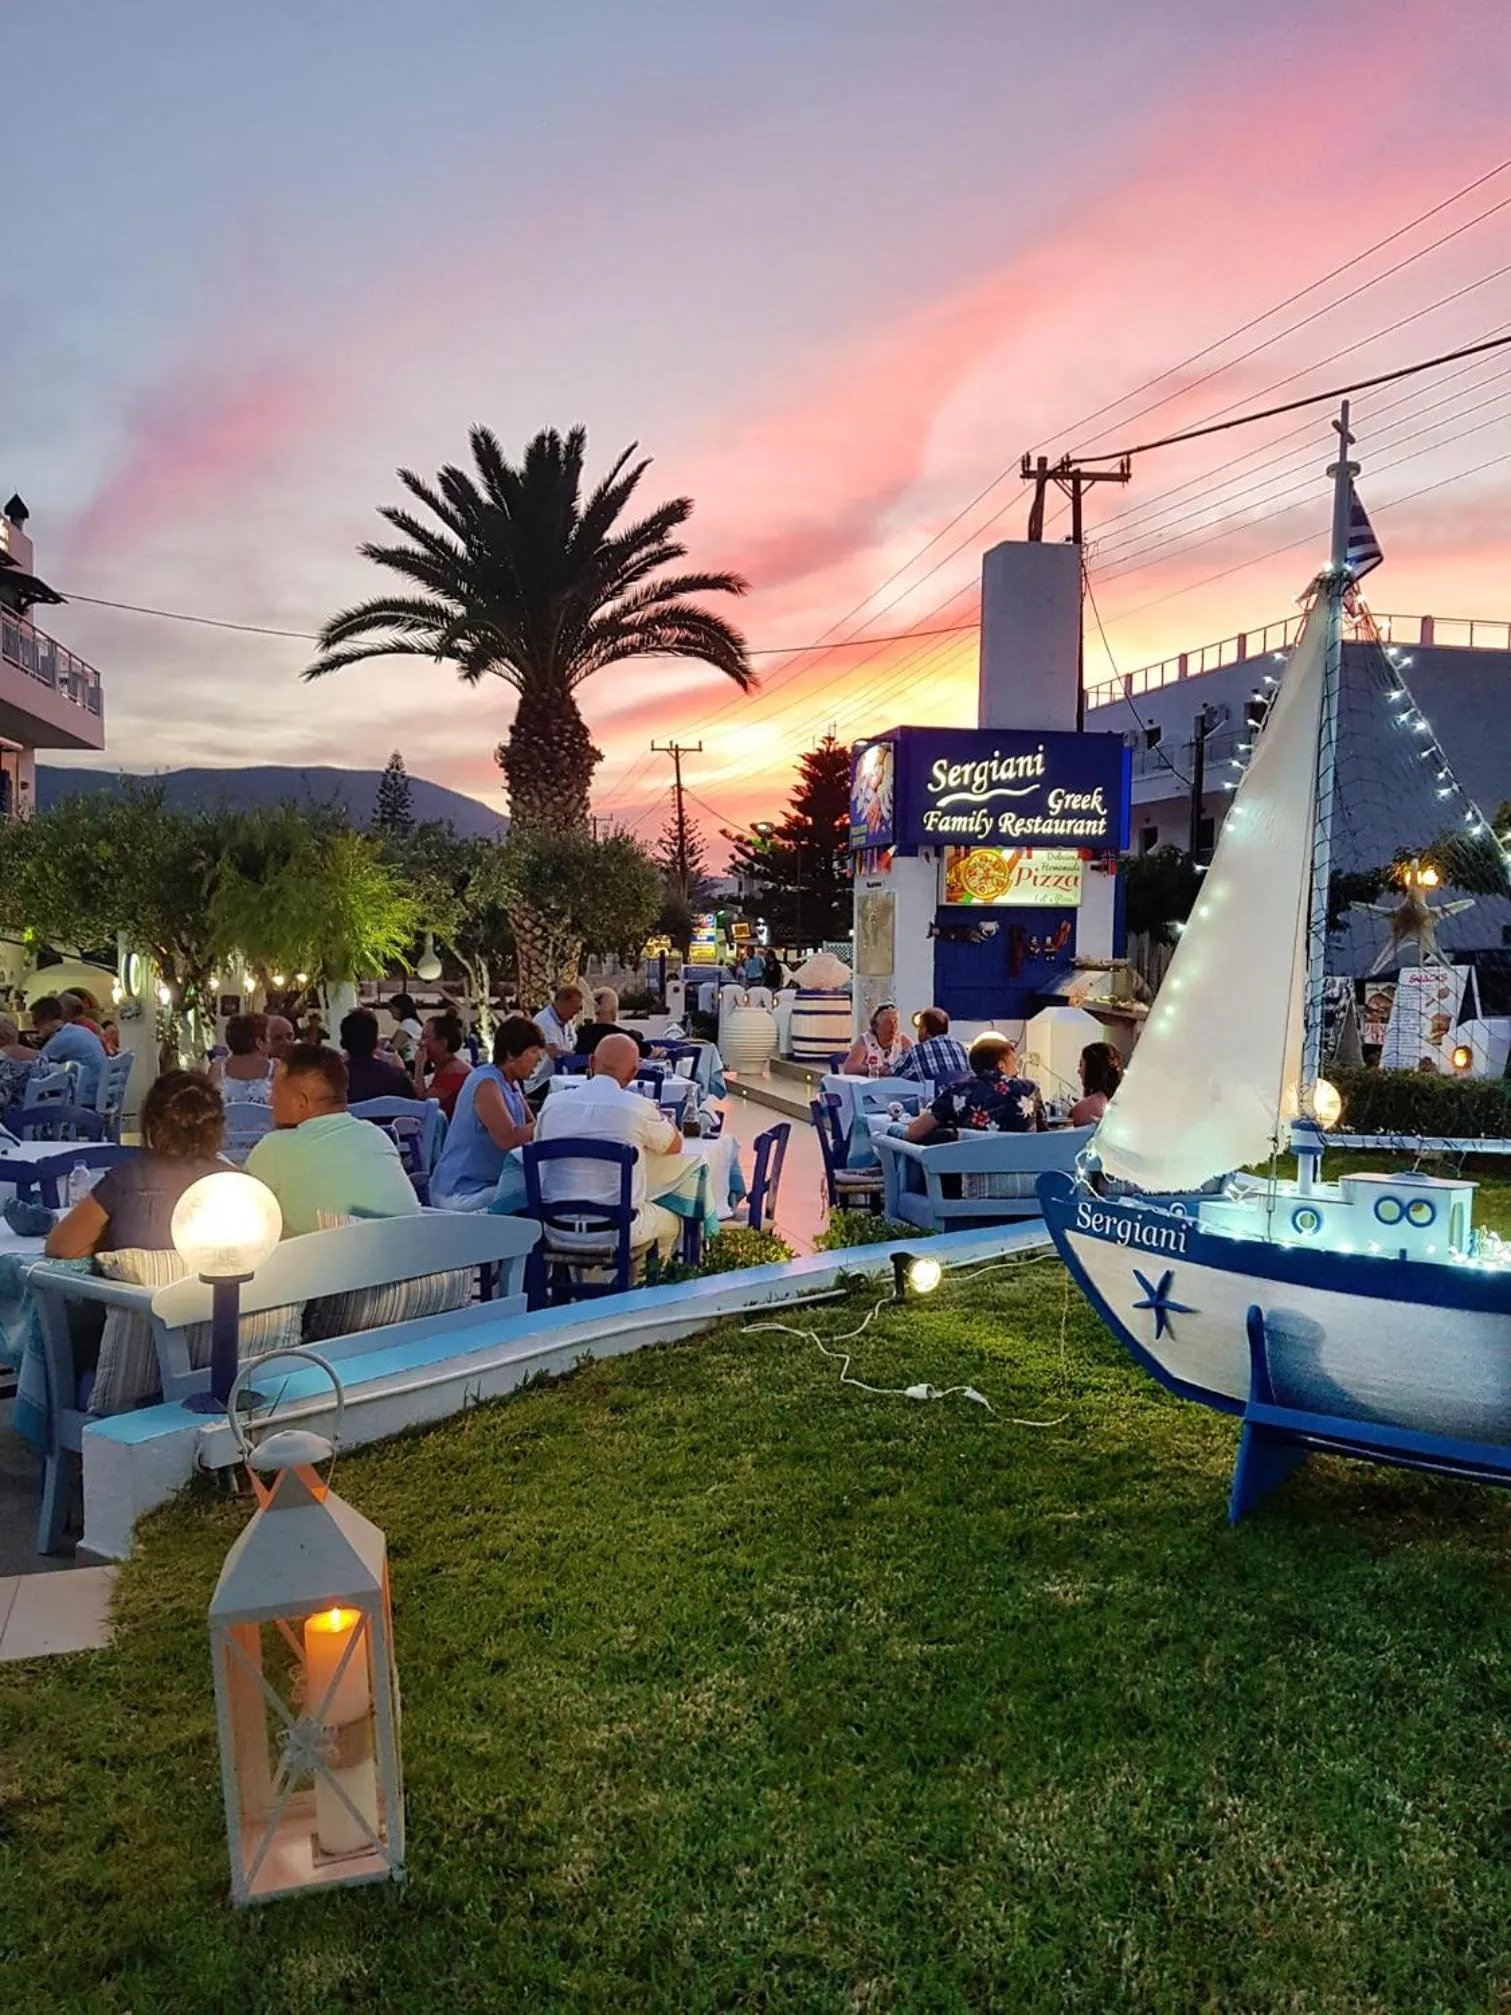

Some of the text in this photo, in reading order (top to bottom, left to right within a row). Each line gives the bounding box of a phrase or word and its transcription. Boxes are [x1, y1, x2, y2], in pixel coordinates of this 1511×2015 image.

[927, 744, 1045, 793] Sergiani
[1047, 787, 1107, 815] Greek
[923, 808, 1107, 840] Family Restaurant
[1014, 867, 1079, 892] Pizza
[1408, 973, 1449, 984] SNACKS
[1076, 1201, 1187, 1253] Sergiani
